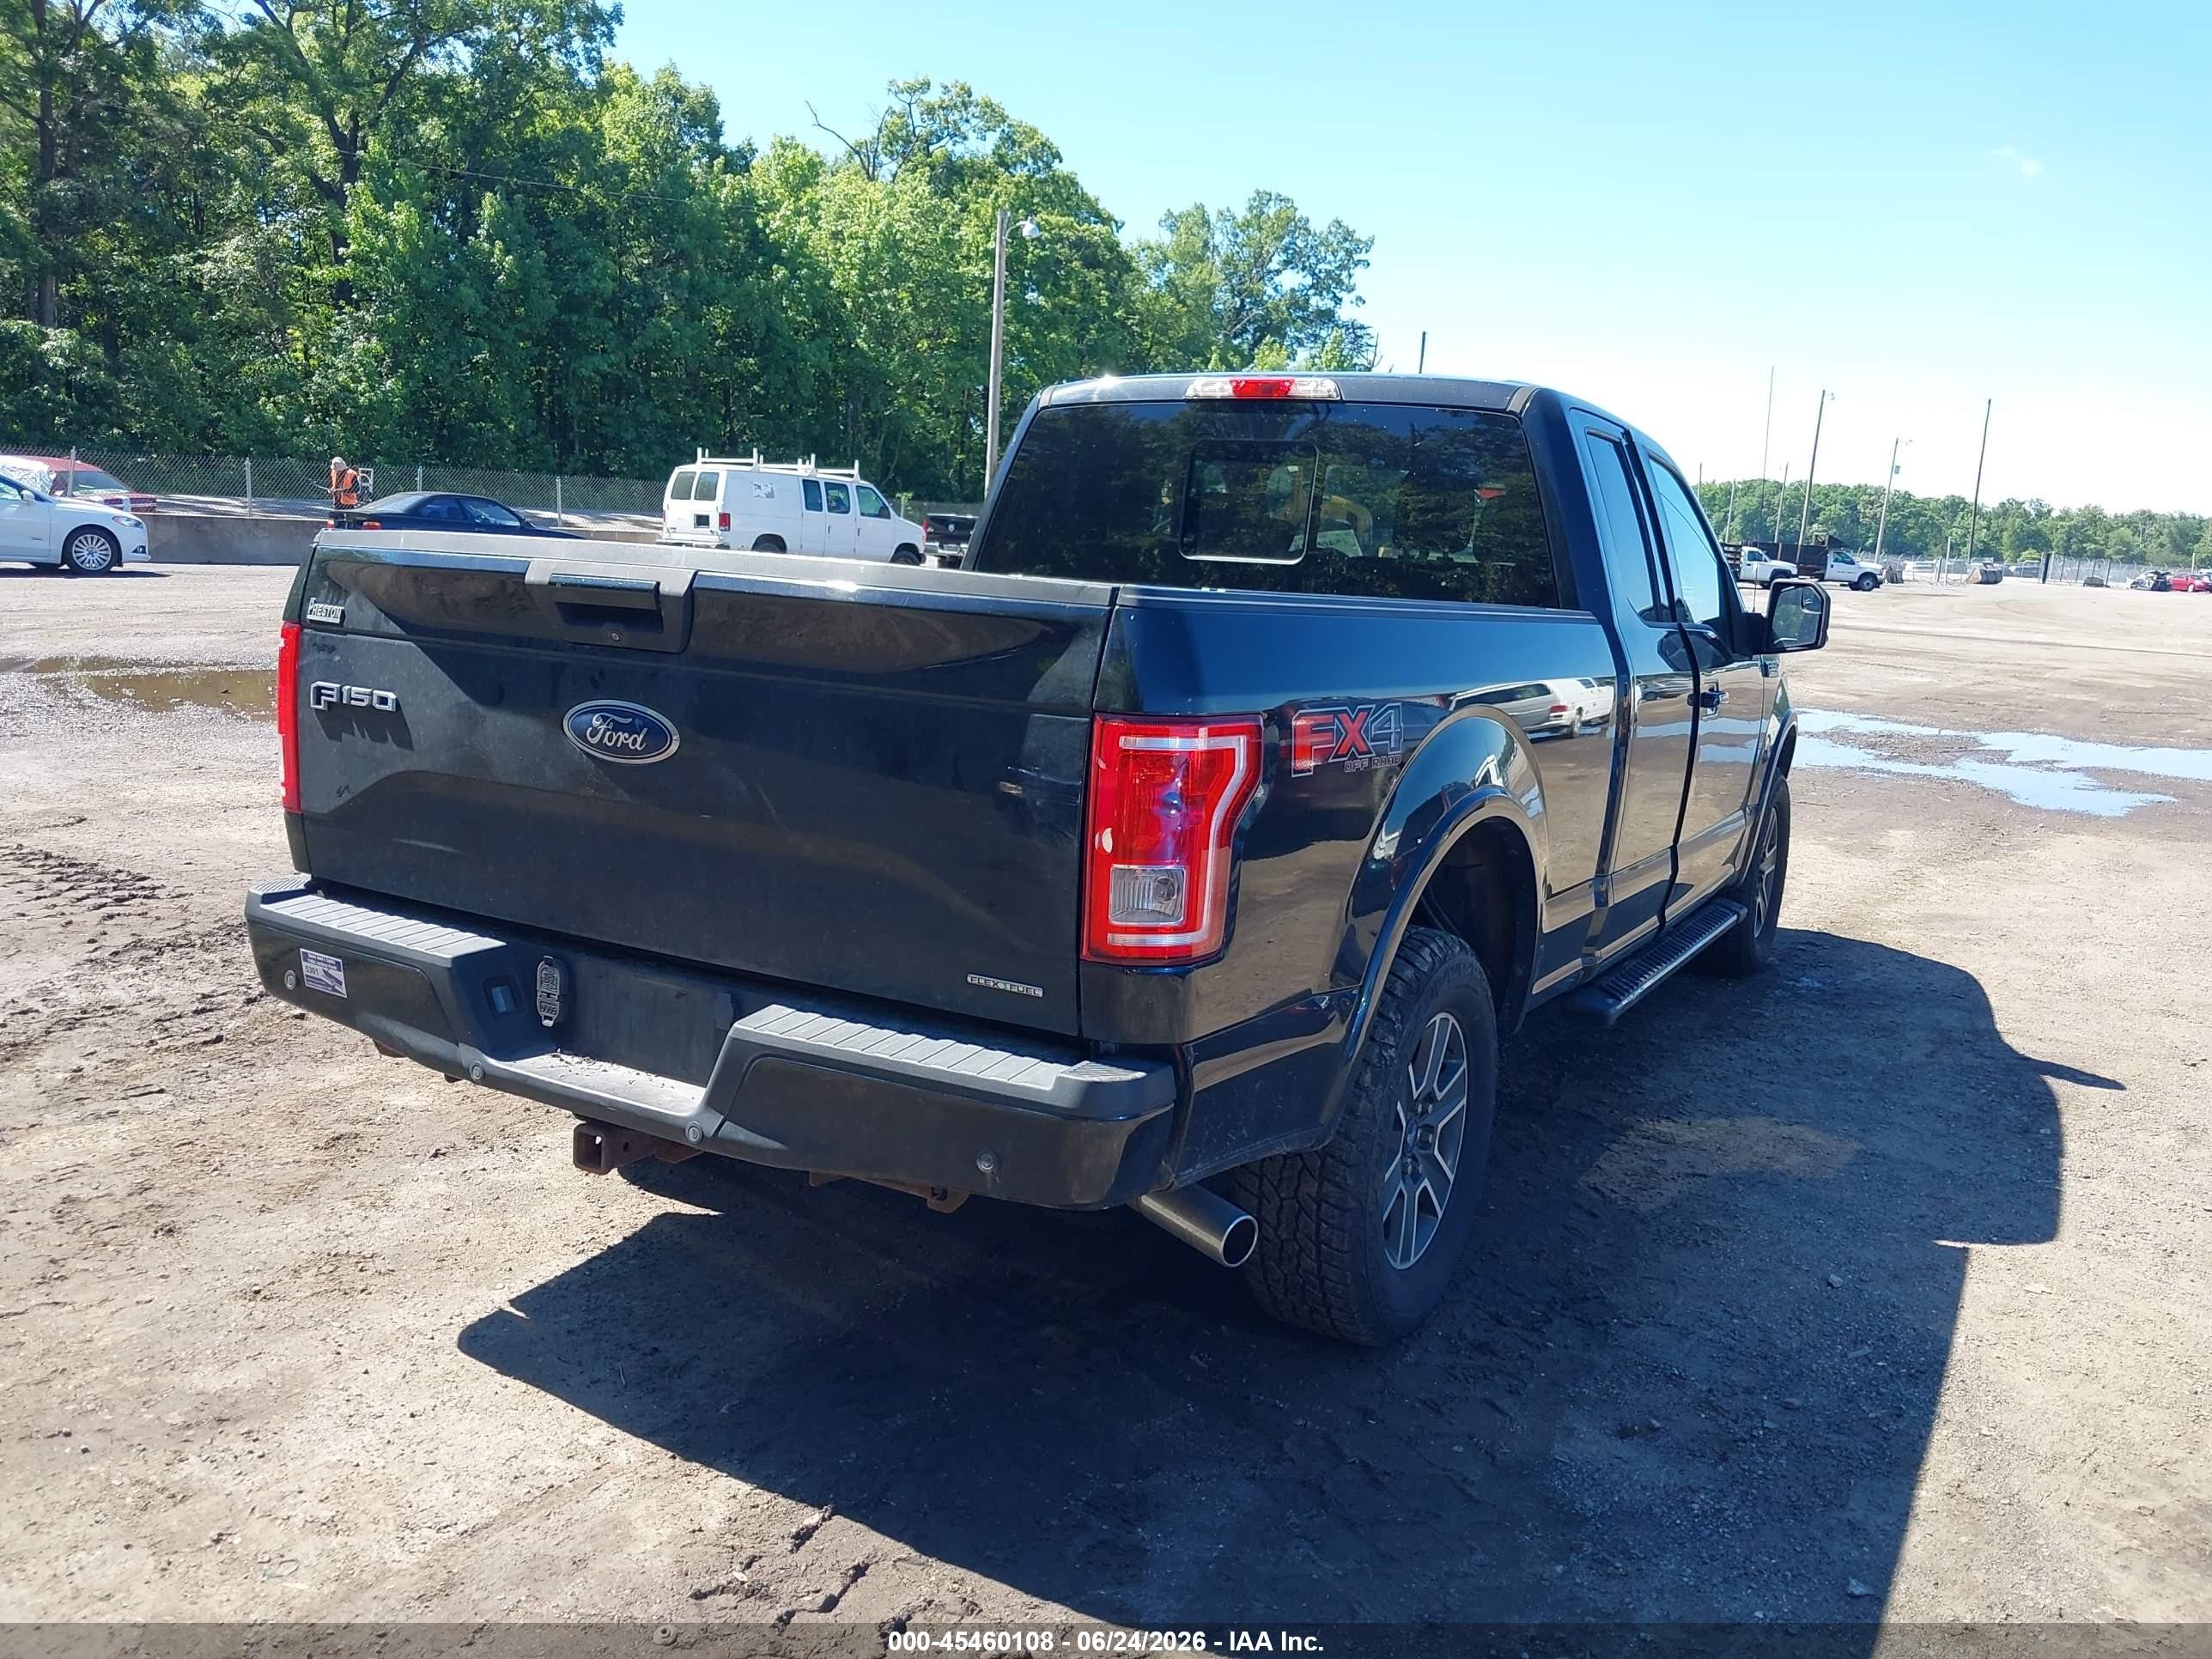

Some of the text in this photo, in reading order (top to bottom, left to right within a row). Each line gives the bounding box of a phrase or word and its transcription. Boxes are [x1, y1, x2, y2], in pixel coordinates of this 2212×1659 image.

[310, 681, 397, 712] F150
[586, 712, 648, 751] Ford
[1291, 702, 1404, 778] FX4
[1344, 754, 1402, 773] OFF ROAD
[969, 975, 1042, 997] FLEX FUEL
